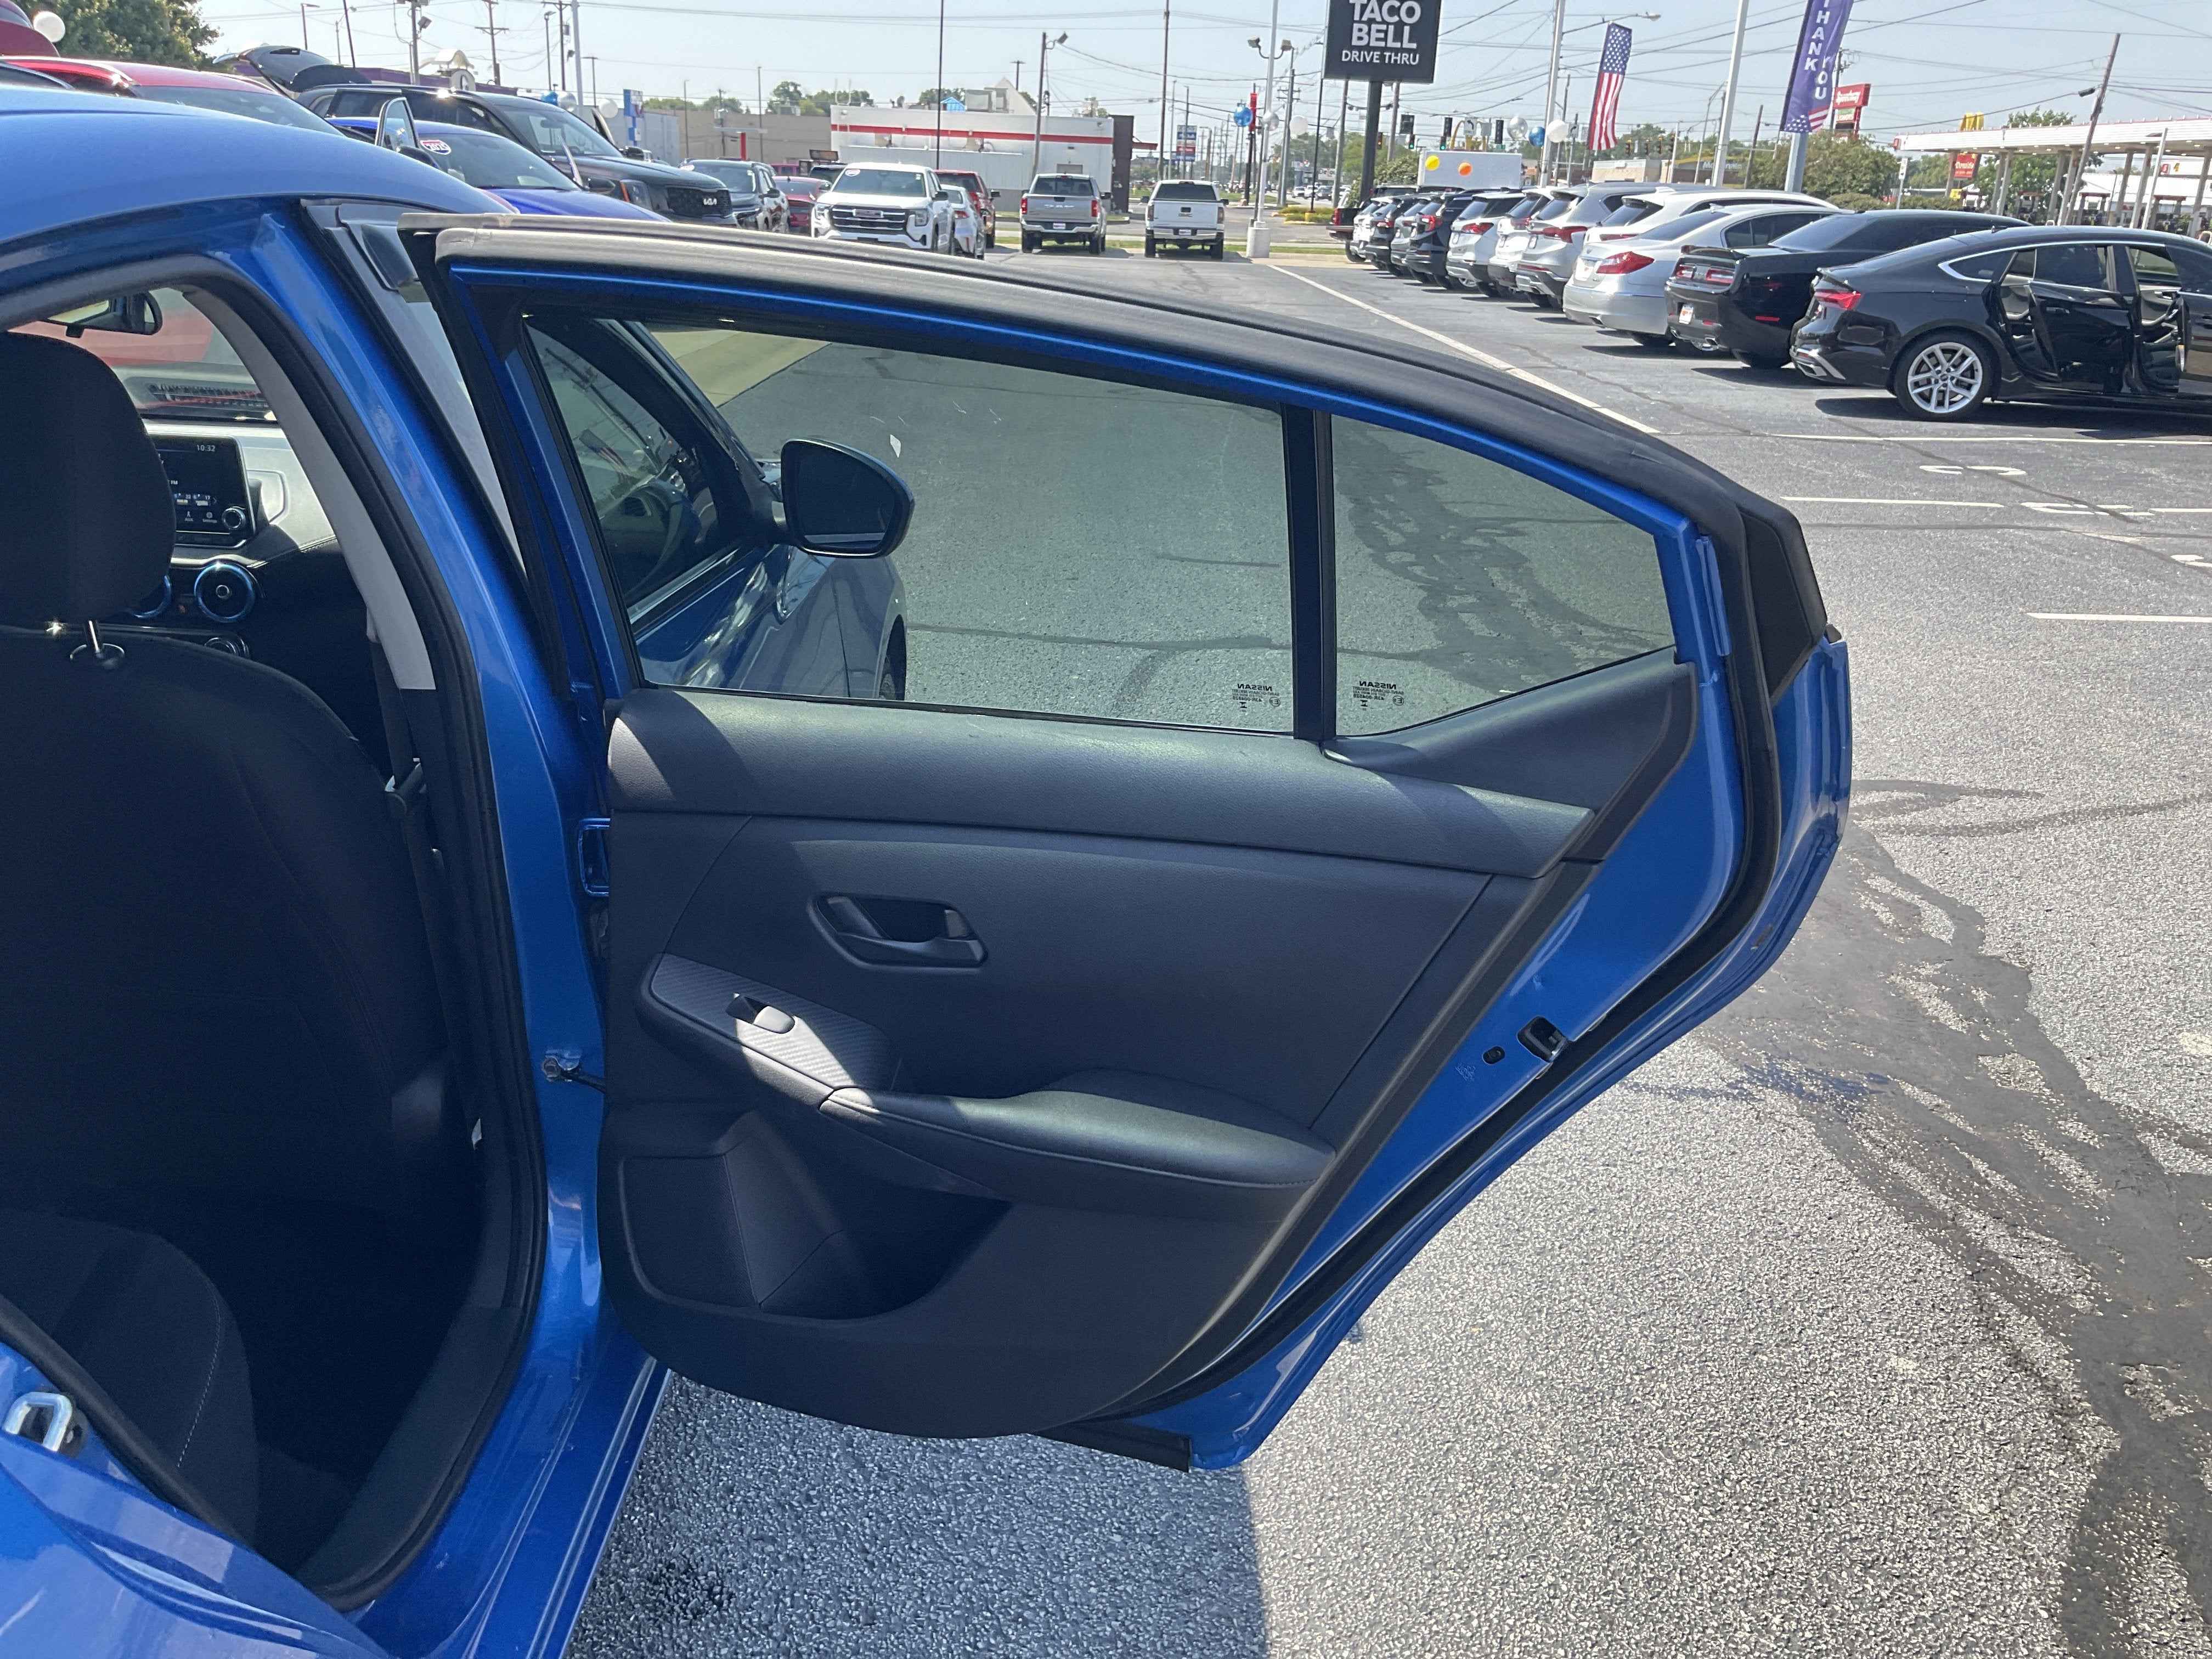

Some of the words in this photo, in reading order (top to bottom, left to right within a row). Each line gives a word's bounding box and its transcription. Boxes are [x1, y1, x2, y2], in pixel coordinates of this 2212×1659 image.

[1349, 0, 1421, 24] TACO
[1351, 23, 1417, 49] BELL
[1341, 50, 1381, 63] DRIVE
[1384, 52, 1419, 65] THRU
[1815, 55, 1831, 100] YOU
[1836, 89, 1861, 105] Speedway
